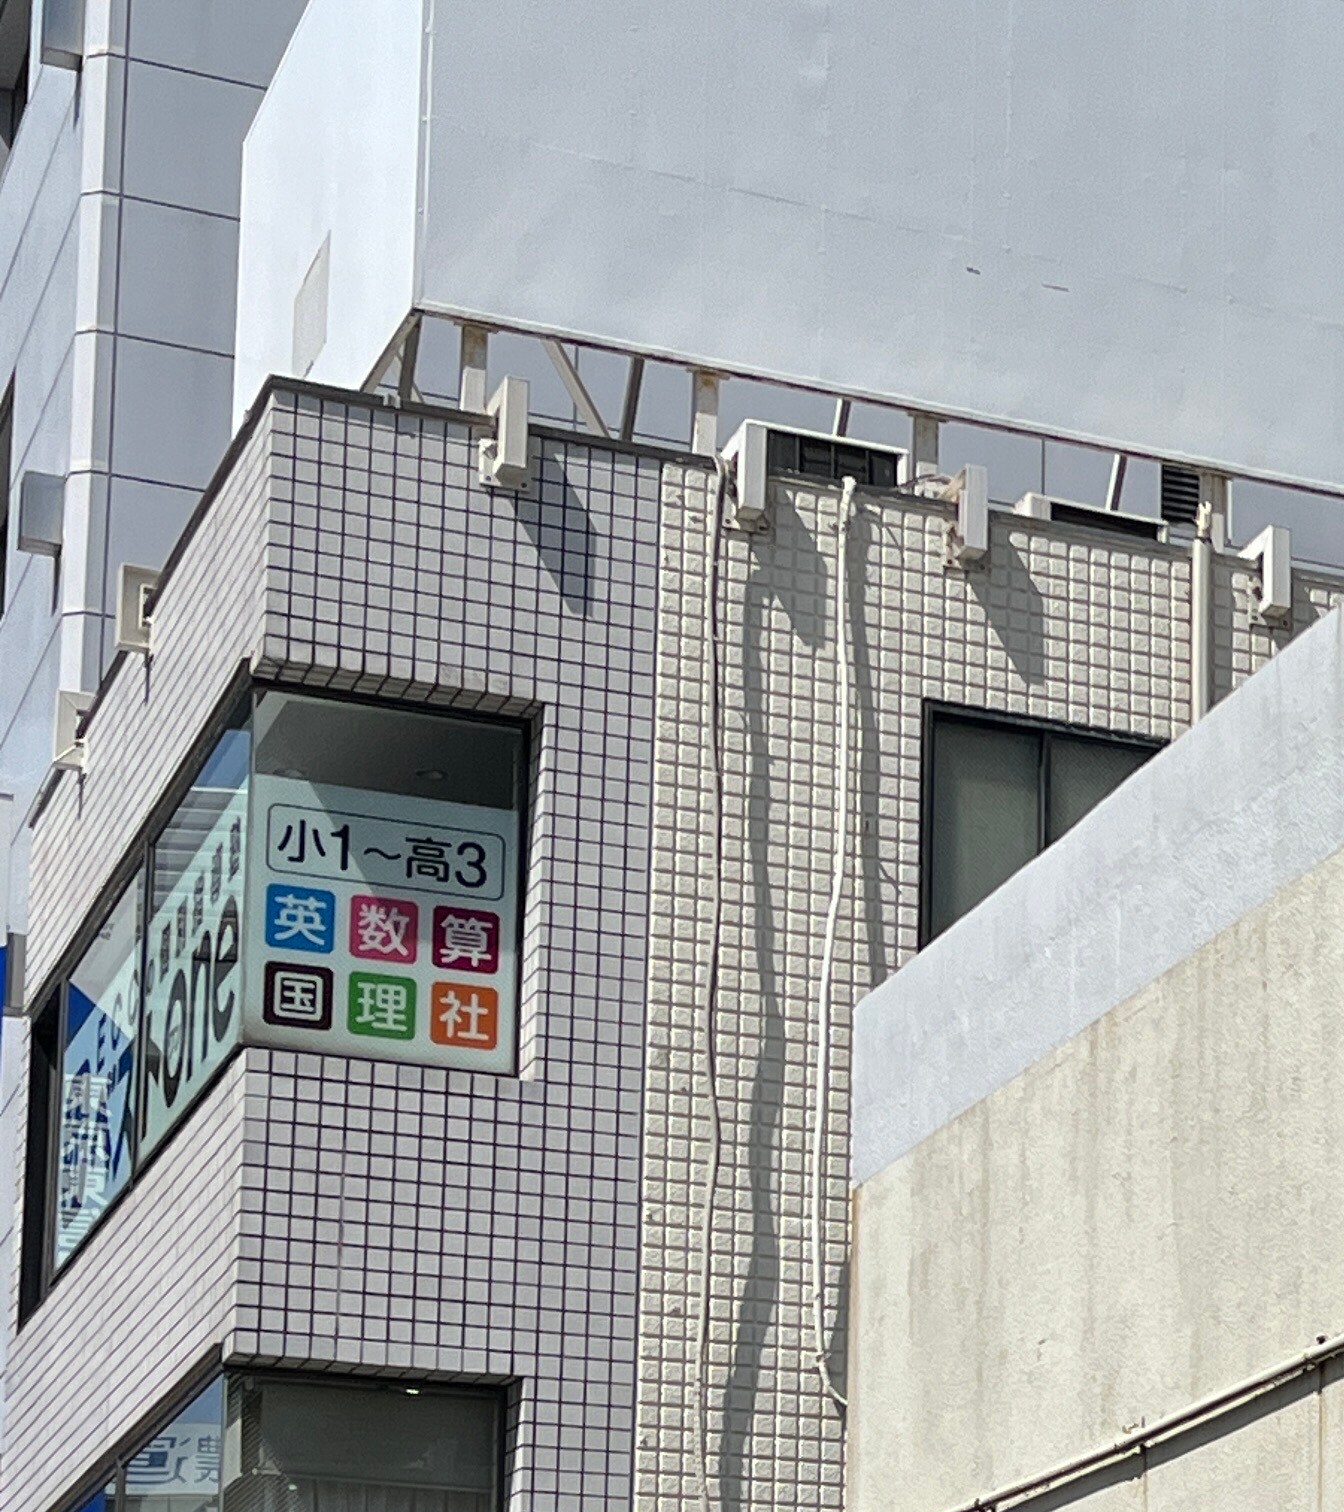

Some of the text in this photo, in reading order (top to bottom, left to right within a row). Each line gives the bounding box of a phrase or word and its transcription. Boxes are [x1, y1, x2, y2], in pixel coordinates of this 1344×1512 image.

[274, 893, 492, 967] 英 数 算
[273, 970, 490, 1041] 国 理 社
